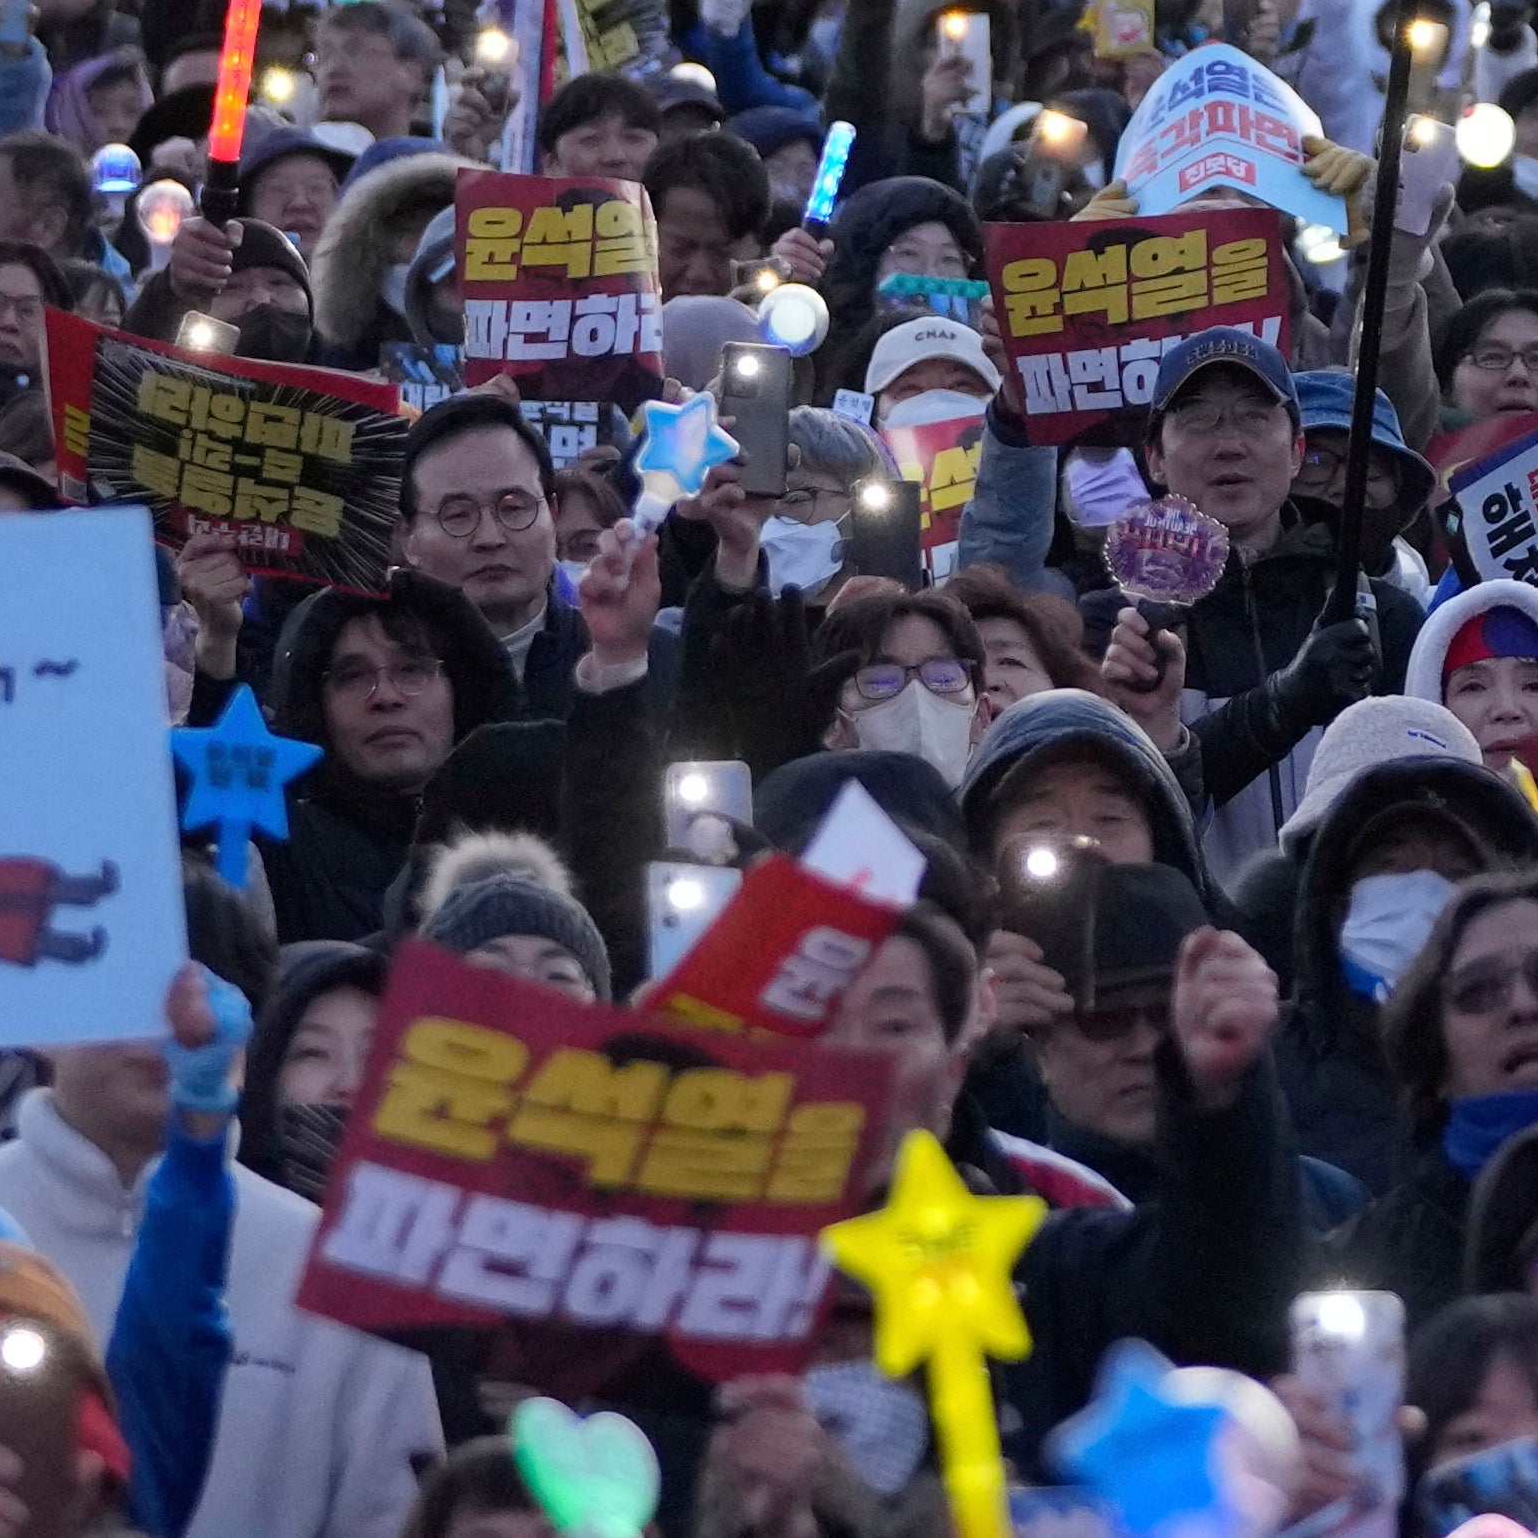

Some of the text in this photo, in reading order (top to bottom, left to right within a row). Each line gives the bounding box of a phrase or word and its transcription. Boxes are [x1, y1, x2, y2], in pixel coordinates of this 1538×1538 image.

[465, 199, 657, 283] 윤석열
[1001, 228, 1269, 339] 윤석열을
[371, 1012, 867, 1205] 윤석열을
[322, 1159, 835, 1342] 파면하라!
